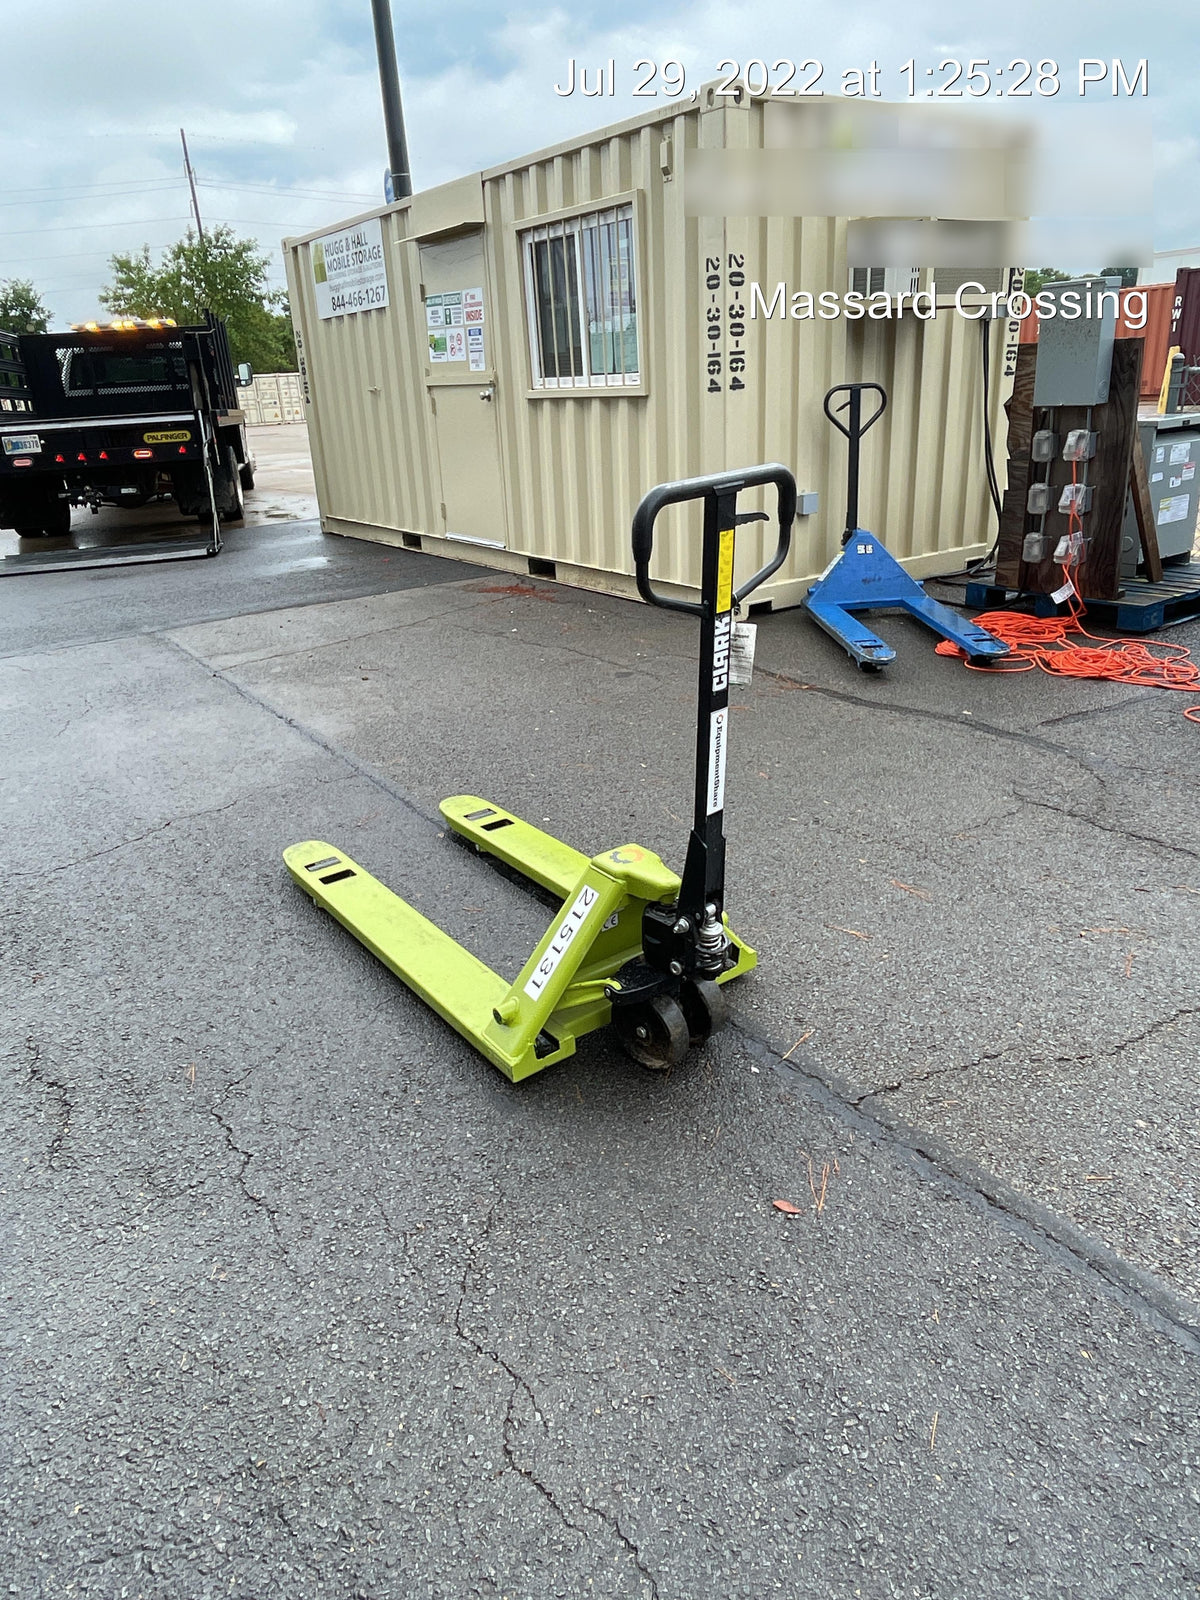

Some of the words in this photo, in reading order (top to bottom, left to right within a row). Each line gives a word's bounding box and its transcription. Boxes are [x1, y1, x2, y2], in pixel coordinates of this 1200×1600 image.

[324, 239, 344, 257] HUGG
[345, 237, 351, 251] &
[351, 231, 368, 249] HALL
[327, 254, 350, 273] MOBILE
[351, 244, 382, 266] STORAGE
[331, 285, 386, 311] 844-466-1267
[706, 257, 721, 393] 20-30-164
[728, 253, 746, 391] 20-30-164
[146, 432, 188, 442] PALFINGER
[712, 614, 731, 692] CLARK
[712, 726, 723, 808] EquipmentShare
[531, 887, 596, 990] 215131
